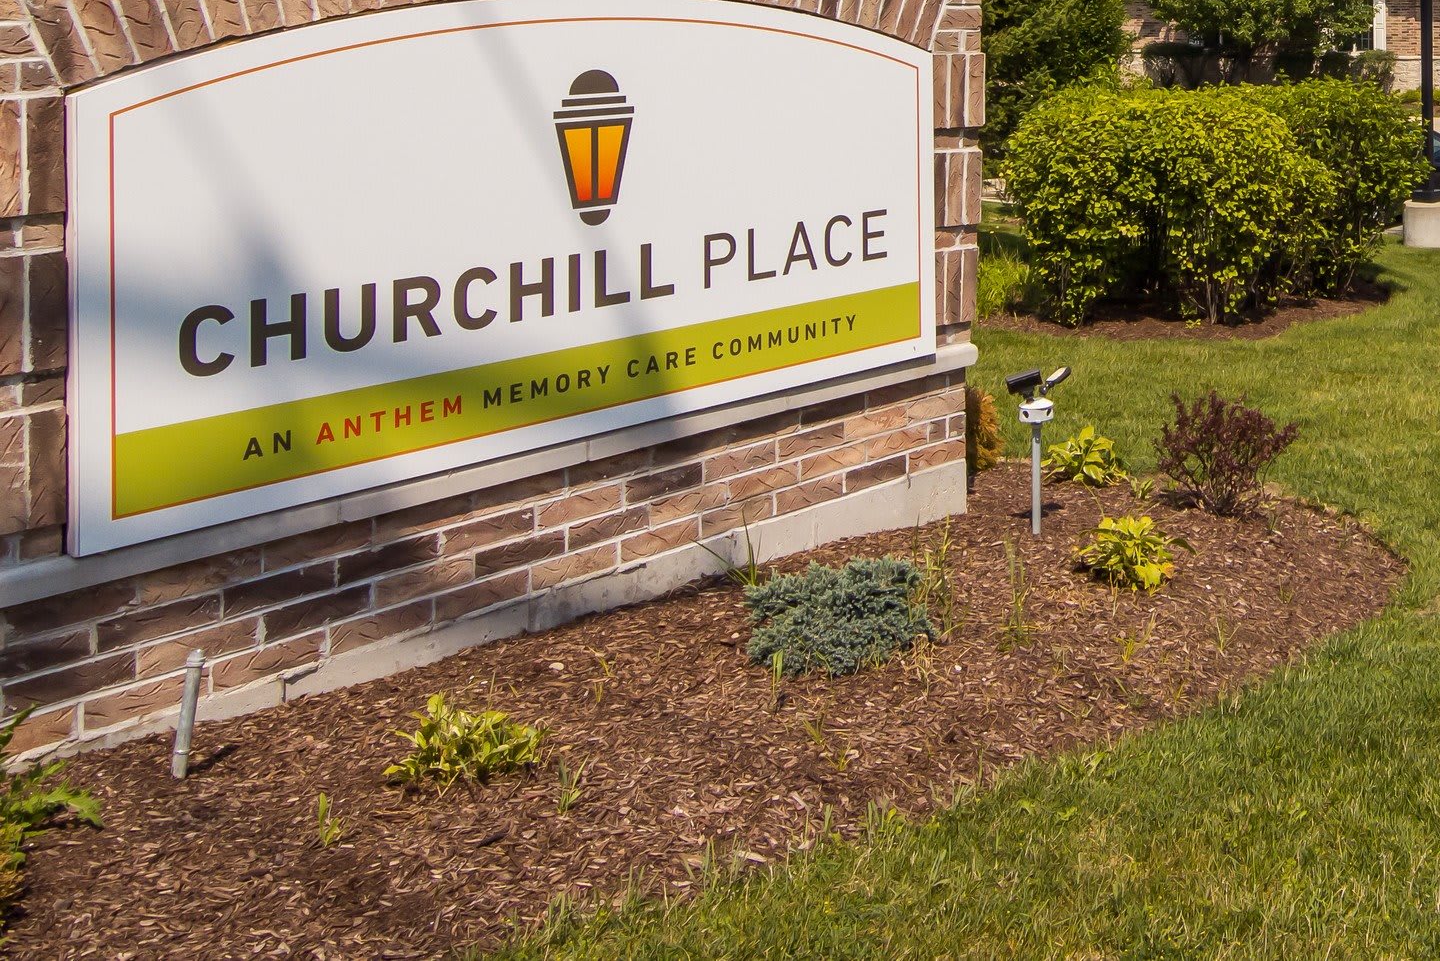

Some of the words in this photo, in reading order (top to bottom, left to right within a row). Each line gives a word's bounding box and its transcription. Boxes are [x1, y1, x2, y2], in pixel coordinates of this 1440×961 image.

[178, 242, 676, 377] CHURCHILL
[703, 208, 889, 289] PLACE
[242, 429, 293, 461] AN
[315, 395, 464, 446] ANTHEM
[482, 365, 612, 410] MEMORY
[626, 347, 698, 379] CARE
[712, 313, 858, 361] COMMUNITY
